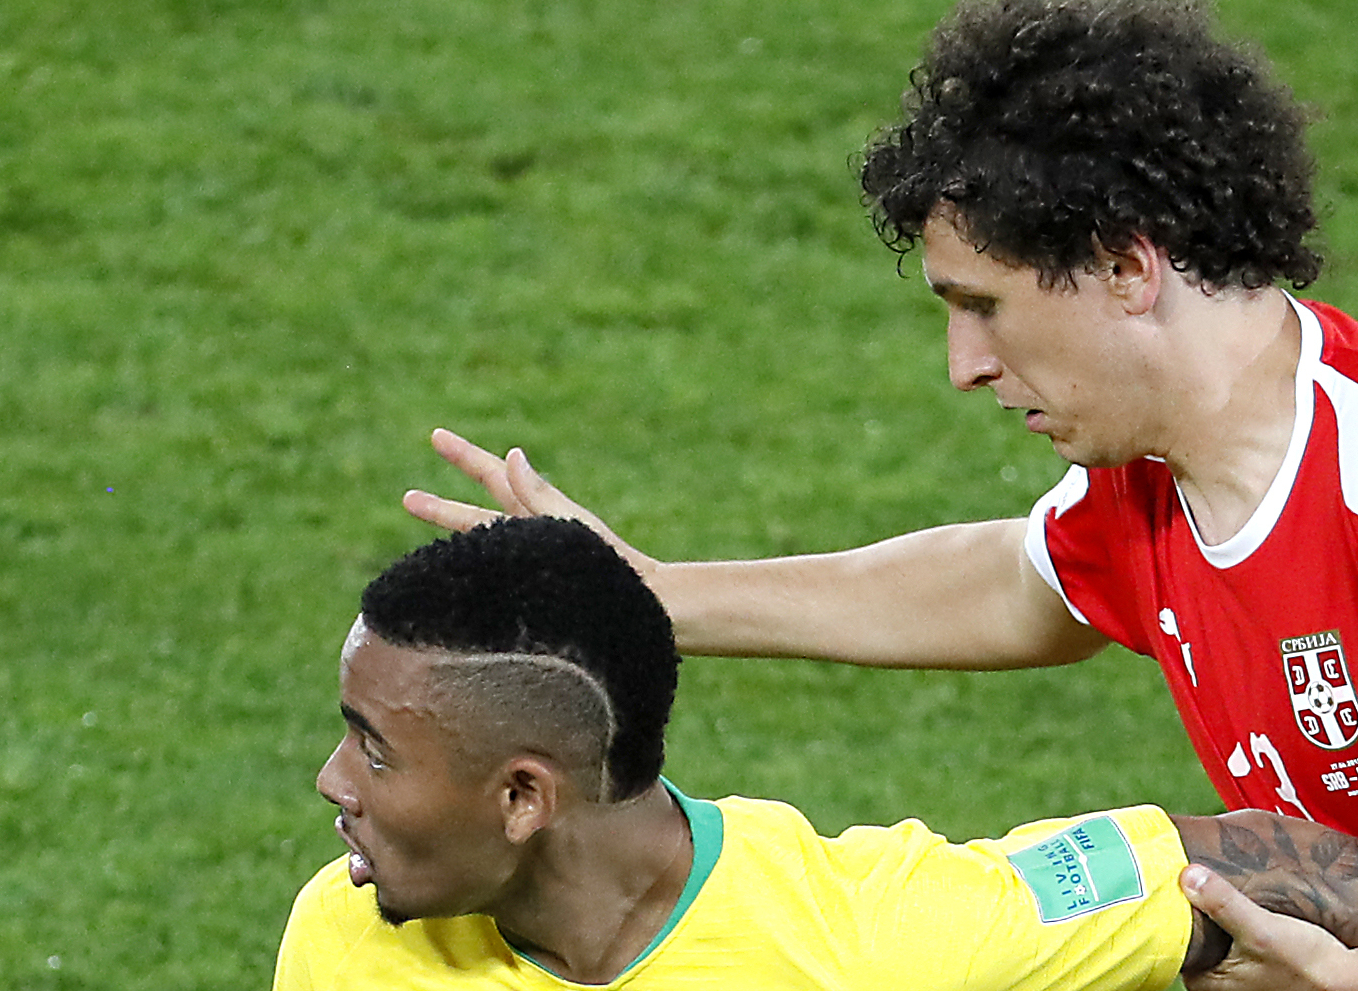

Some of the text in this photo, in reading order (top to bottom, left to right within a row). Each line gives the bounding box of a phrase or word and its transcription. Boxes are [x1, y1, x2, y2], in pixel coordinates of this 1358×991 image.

[1281, 632, 1337, 652] СРБИЈА
[1321, 771, 1350, 791] SRB
[1072, 828, 1095, 850] FIFA
[1038, 844, 1077, 910] LIVING
